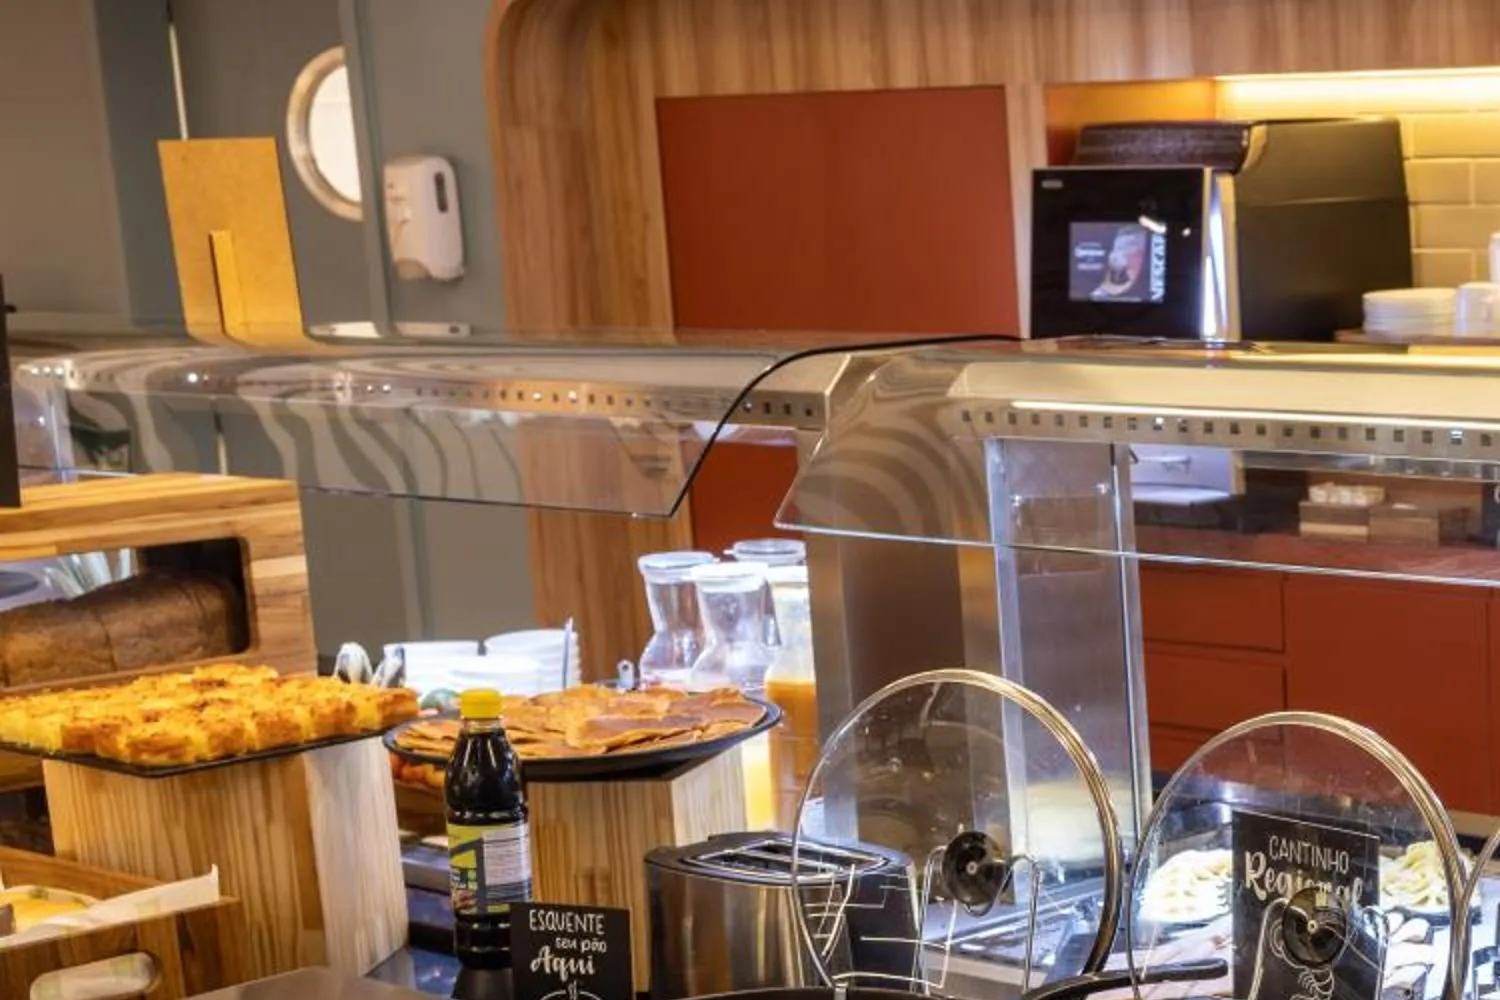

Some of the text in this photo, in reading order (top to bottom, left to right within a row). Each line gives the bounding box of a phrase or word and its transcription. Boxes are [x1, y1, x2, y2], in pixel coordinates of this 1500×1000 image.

[1269, 835, 1349, 875] CANTINHO
[529, 909, 605, 936] ESQUENTE
[555, 937, 608, 953] seu pão
[530, 945, 596, 982] Aqui
